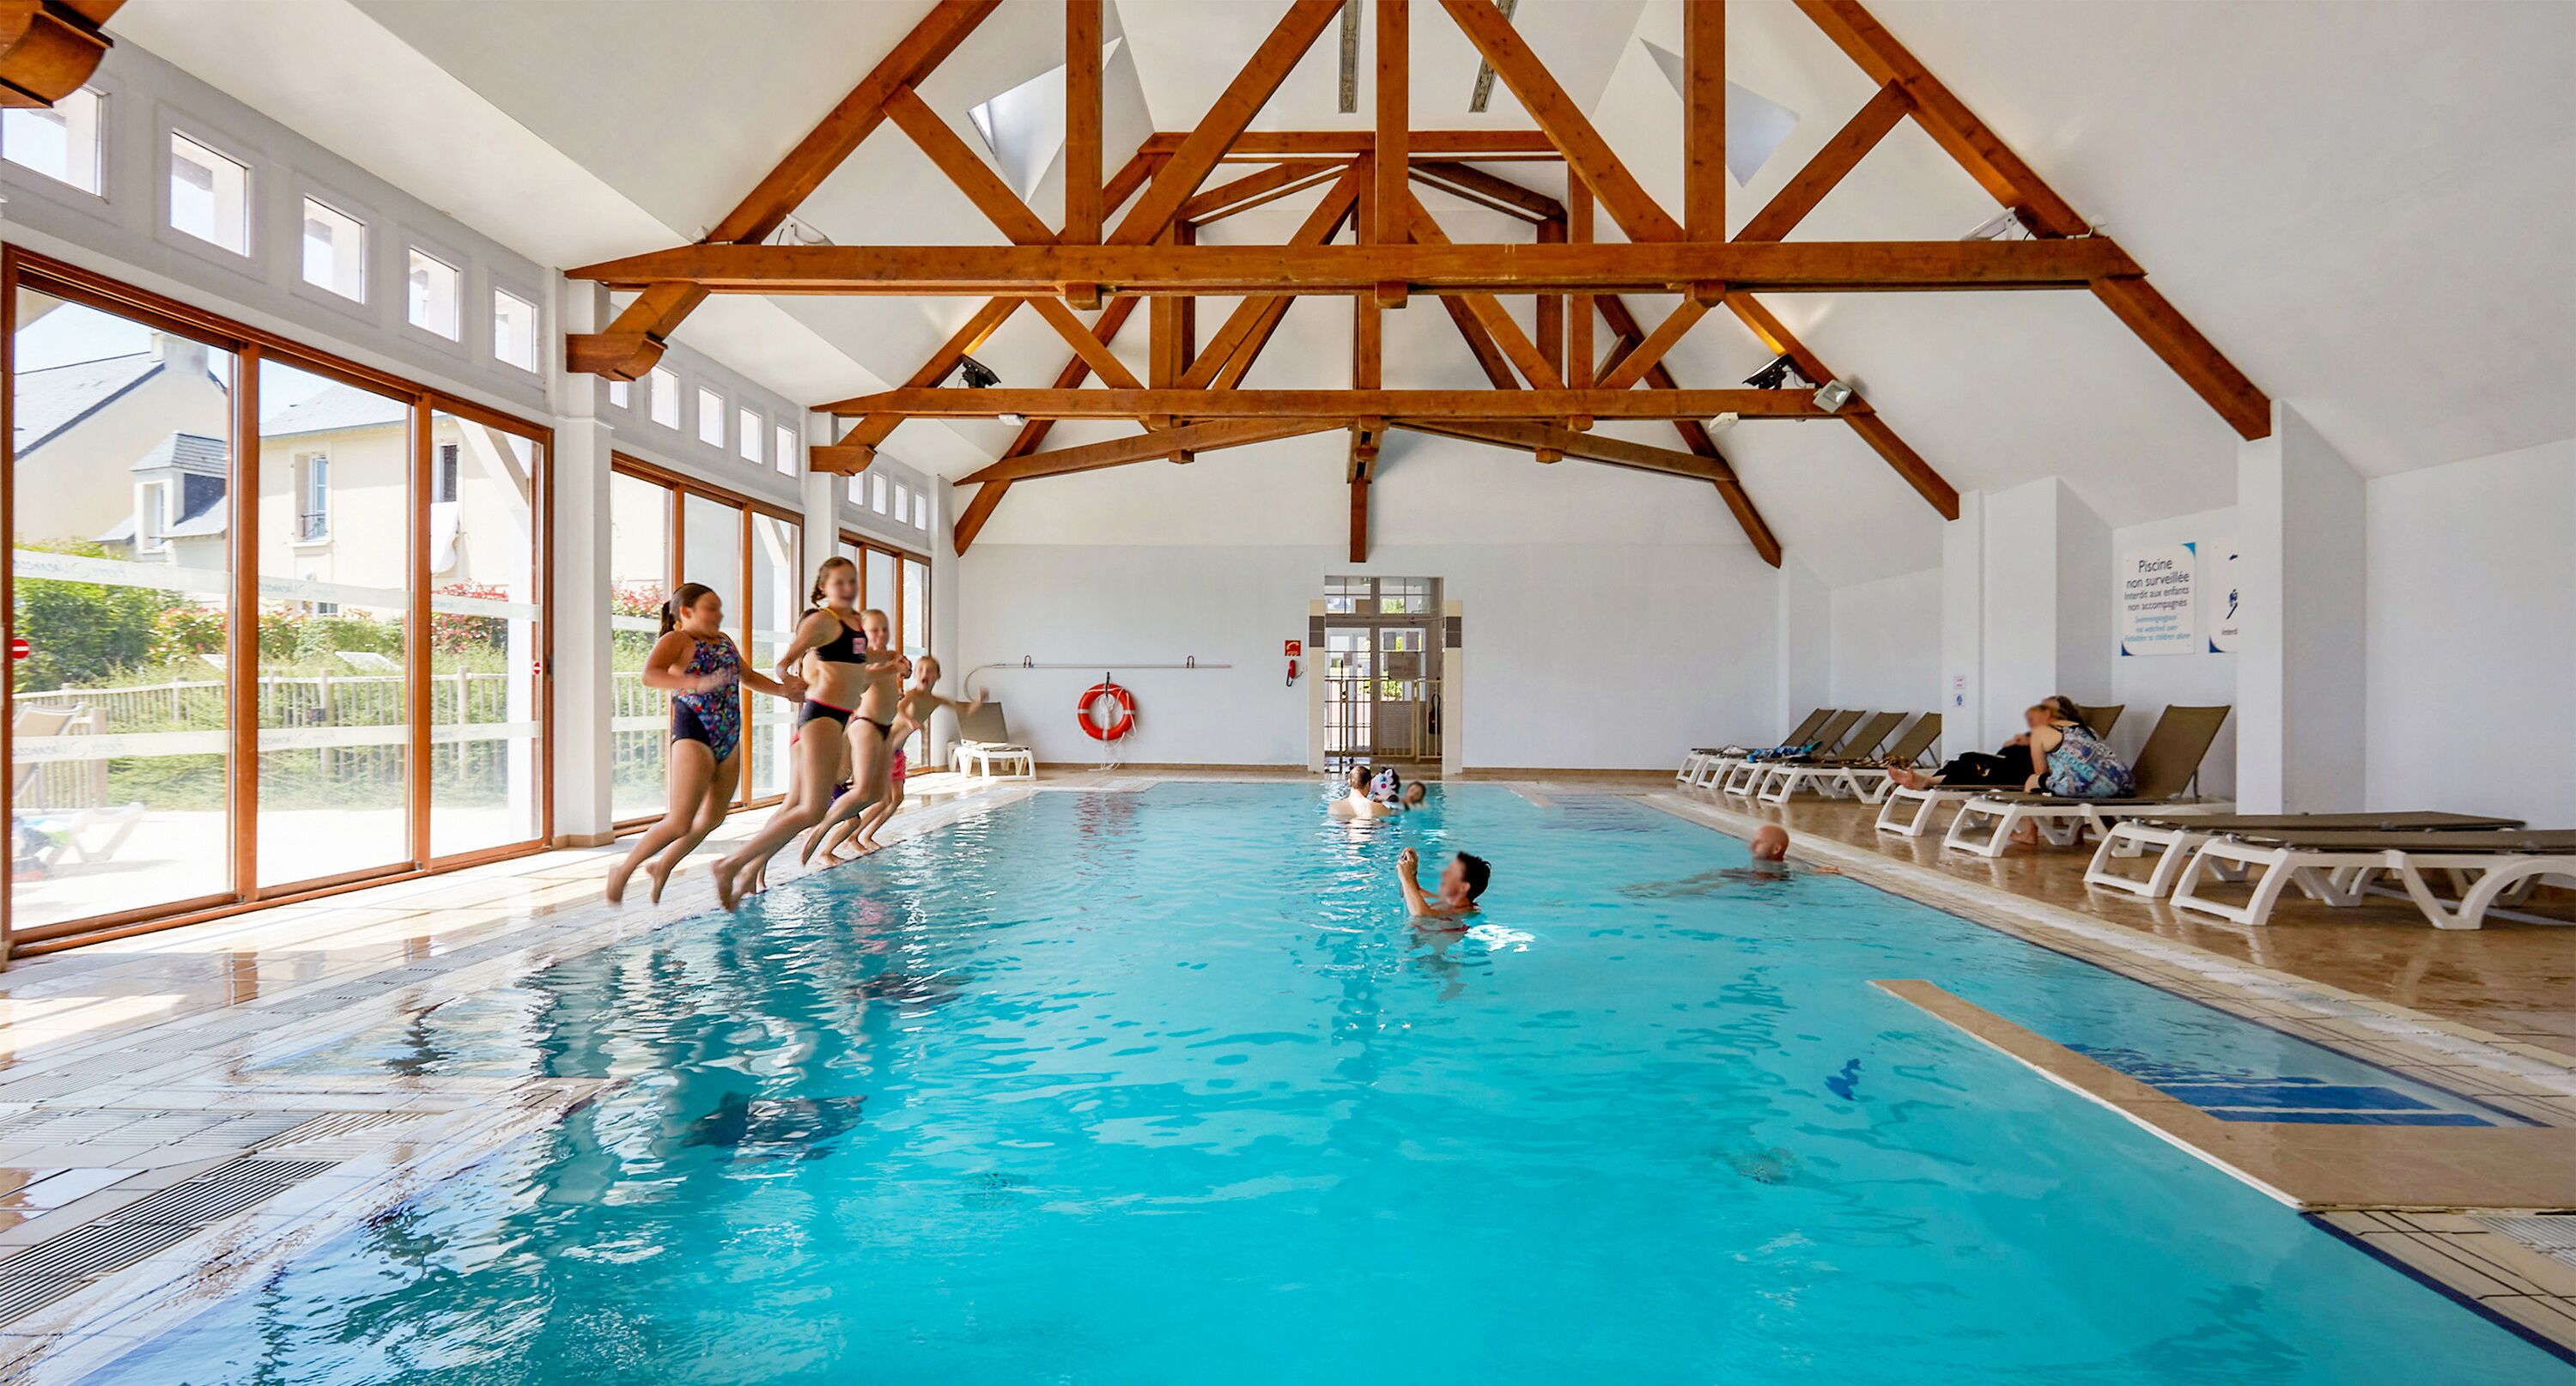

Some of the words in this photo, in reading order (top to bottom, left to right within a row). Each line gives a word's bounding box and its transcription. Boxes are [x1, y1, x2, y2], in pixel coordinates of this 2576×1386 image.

[2138, 558, 2173, 573] Piscine
[2126, 579, 2143, 589] non
[2146, 571, 2190, 587] surveillée
[2124, 590, 2148, 600] Interdit
[2149, 590, 2162, 599] aux
[2164, 586, 2190, 596] enfants
[2142, 598, 2188, 611] accompagnés
